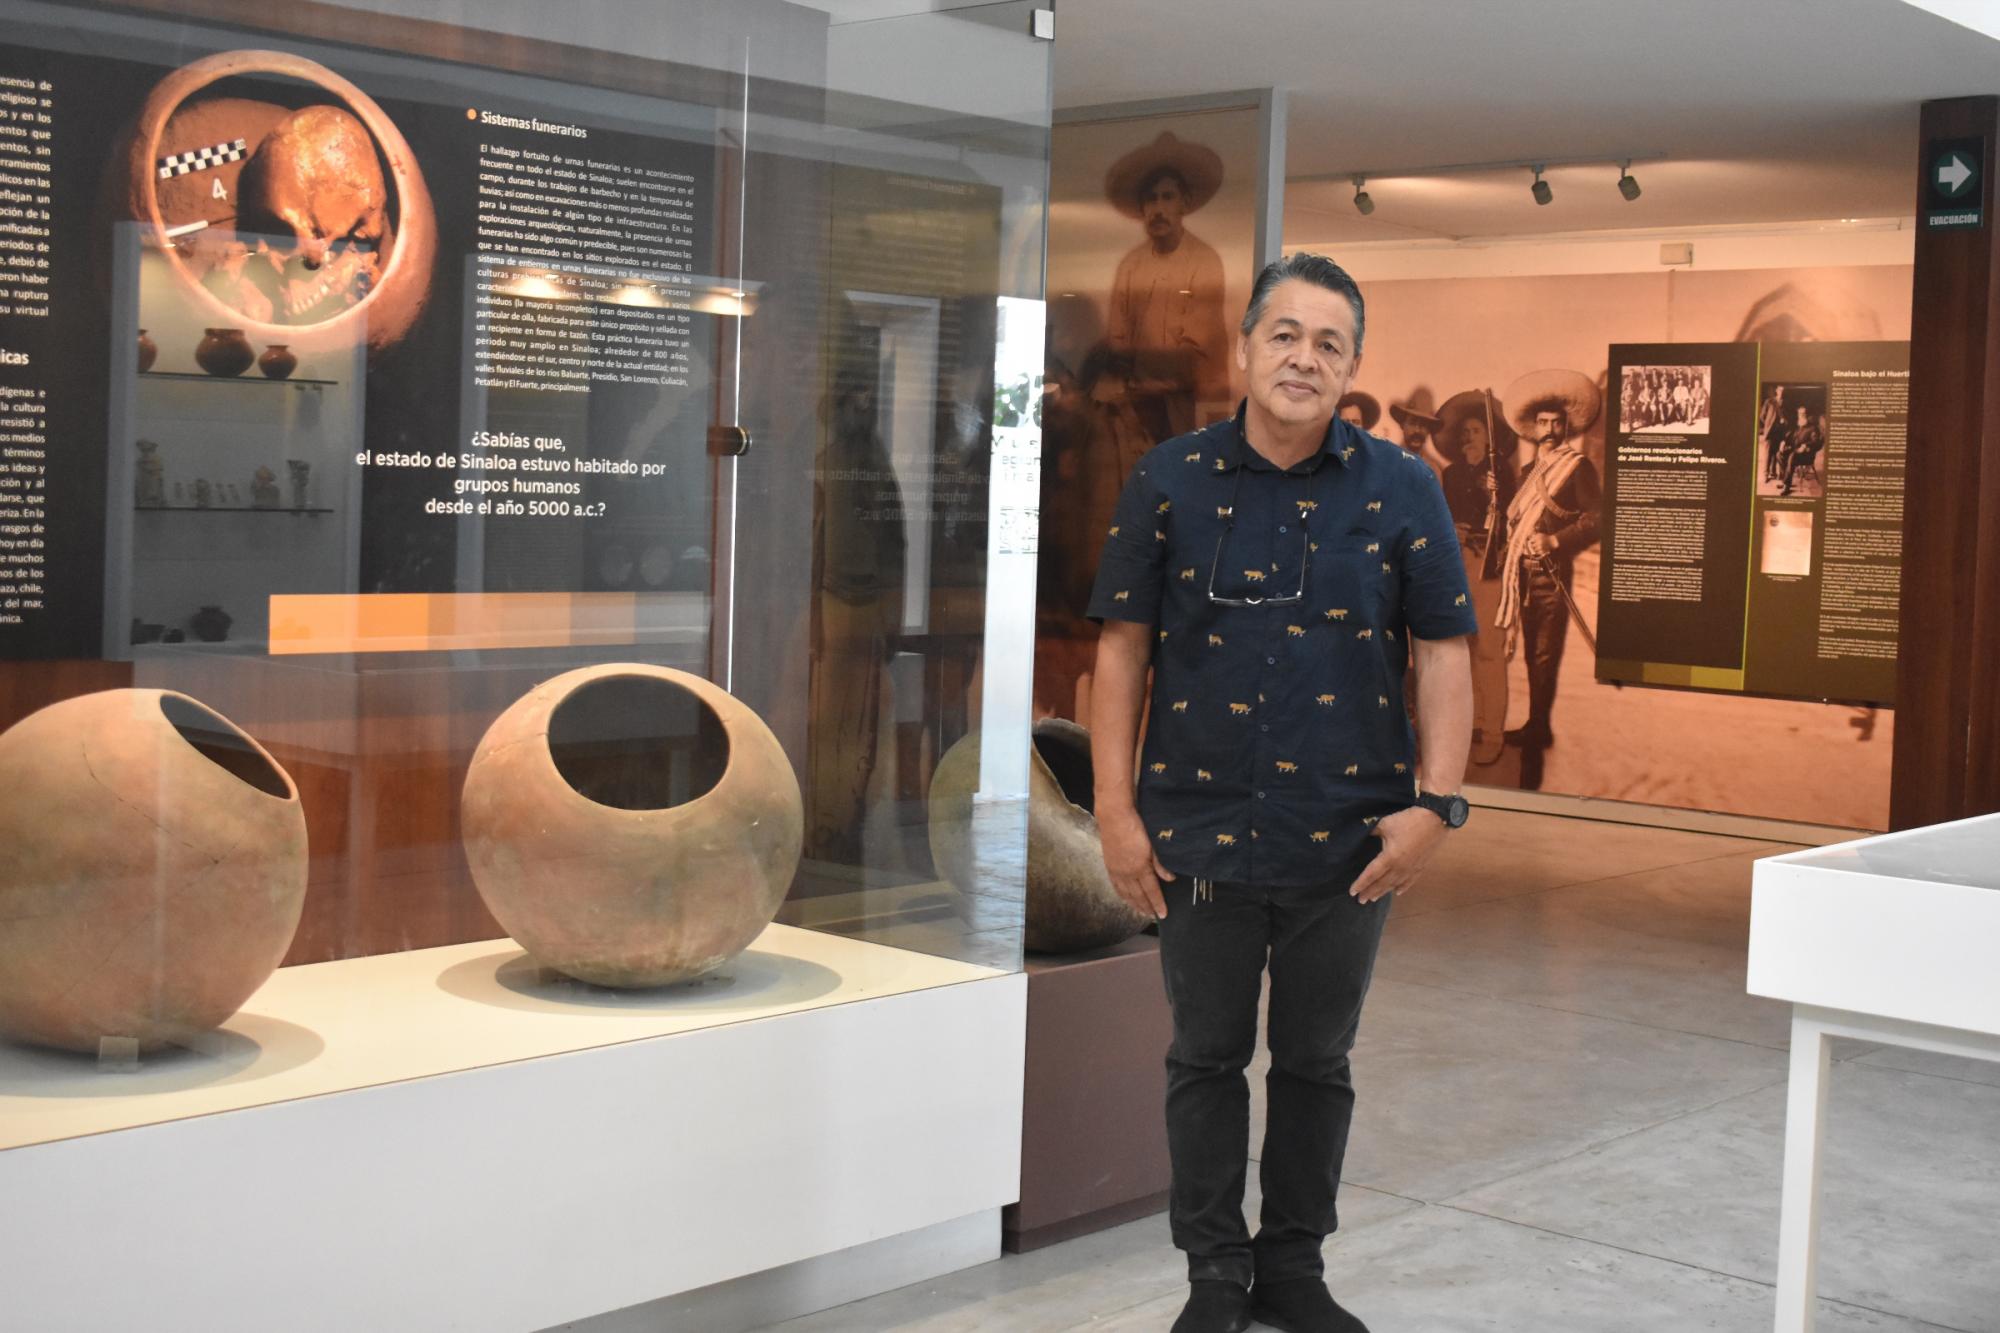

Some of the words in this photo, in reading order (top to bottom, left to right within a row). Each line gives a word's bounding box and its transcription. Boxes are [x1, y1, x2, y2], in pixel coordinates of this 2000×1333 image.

[40, 81, 52, 91] de
[41, 99, 52, 107] se
[38, 113, 51, 123] los
[481, 111, 530, 130] Sistemas
[532, 119, 587, 138] funerarios
[32, 130, 51, 139] que
[36, 146, 50, 155] sin
[38, 177, 50, 188] las
[212, 178, 228, 200] 4
[26, 209, 38, 218] de
[42, 210, 49, 220] la
[1930, 213, 1978, 225] EVACUACIÓN
[38, 242, 49, 252] de
[9, 257, 35, 266] debió
[37, 259, 49, 268] de
[22, 274, 49, 284] haber
[14, 290, 49, 300] ruptura
[16, 307, 48, 316] virtual
[1, 402, 9, 411] la
[13, 403, 45, 412] cultura
[0, 417, 35, 427] resistió
[13, 434, 45, 443] medios
[472, 432, 529, 448] ¿Sabías
[535, 437, 566, 451] que,
[4, 448, 45, 458] términos
[13, 464, 36, 472] ideas
[356, 451, 370, 465] el
[377, 451, 431, 467] estado
[436, 453, 456, 468] de
[461, 454, 516, 470] Sinaloa
[521, 458, 570, 472] estuvo
[575, 458, 638, 474] habitado
[642, 462, 665, 477] por
[36, 479, 44, 488] al
[454, 478, 508, 494] grupos
[513, 479, 580, 494] humanos
[27, 496, 44, 504] que
[425, 498, 473, 514] desde
[478, 499, 491, 514] el
[496, 500, 524, 515] año
[529, 502, 569, 515] 5000
[574, 502, 606, 516] a.c.?
[24, 509, 35, 518] En
[36, 509, 44, 518] la
[1, 525, 30, 534] rasgos
[33, 524, 44, 533] de
[30, 539, 44, 548] día
[9, 554, 44, 563] muchos
[31, 569, 44, 578] los
[20, 584, 43, 594] chile,
[5, 599, 19, 608] del
[24, 600, 43, 608] mar,
